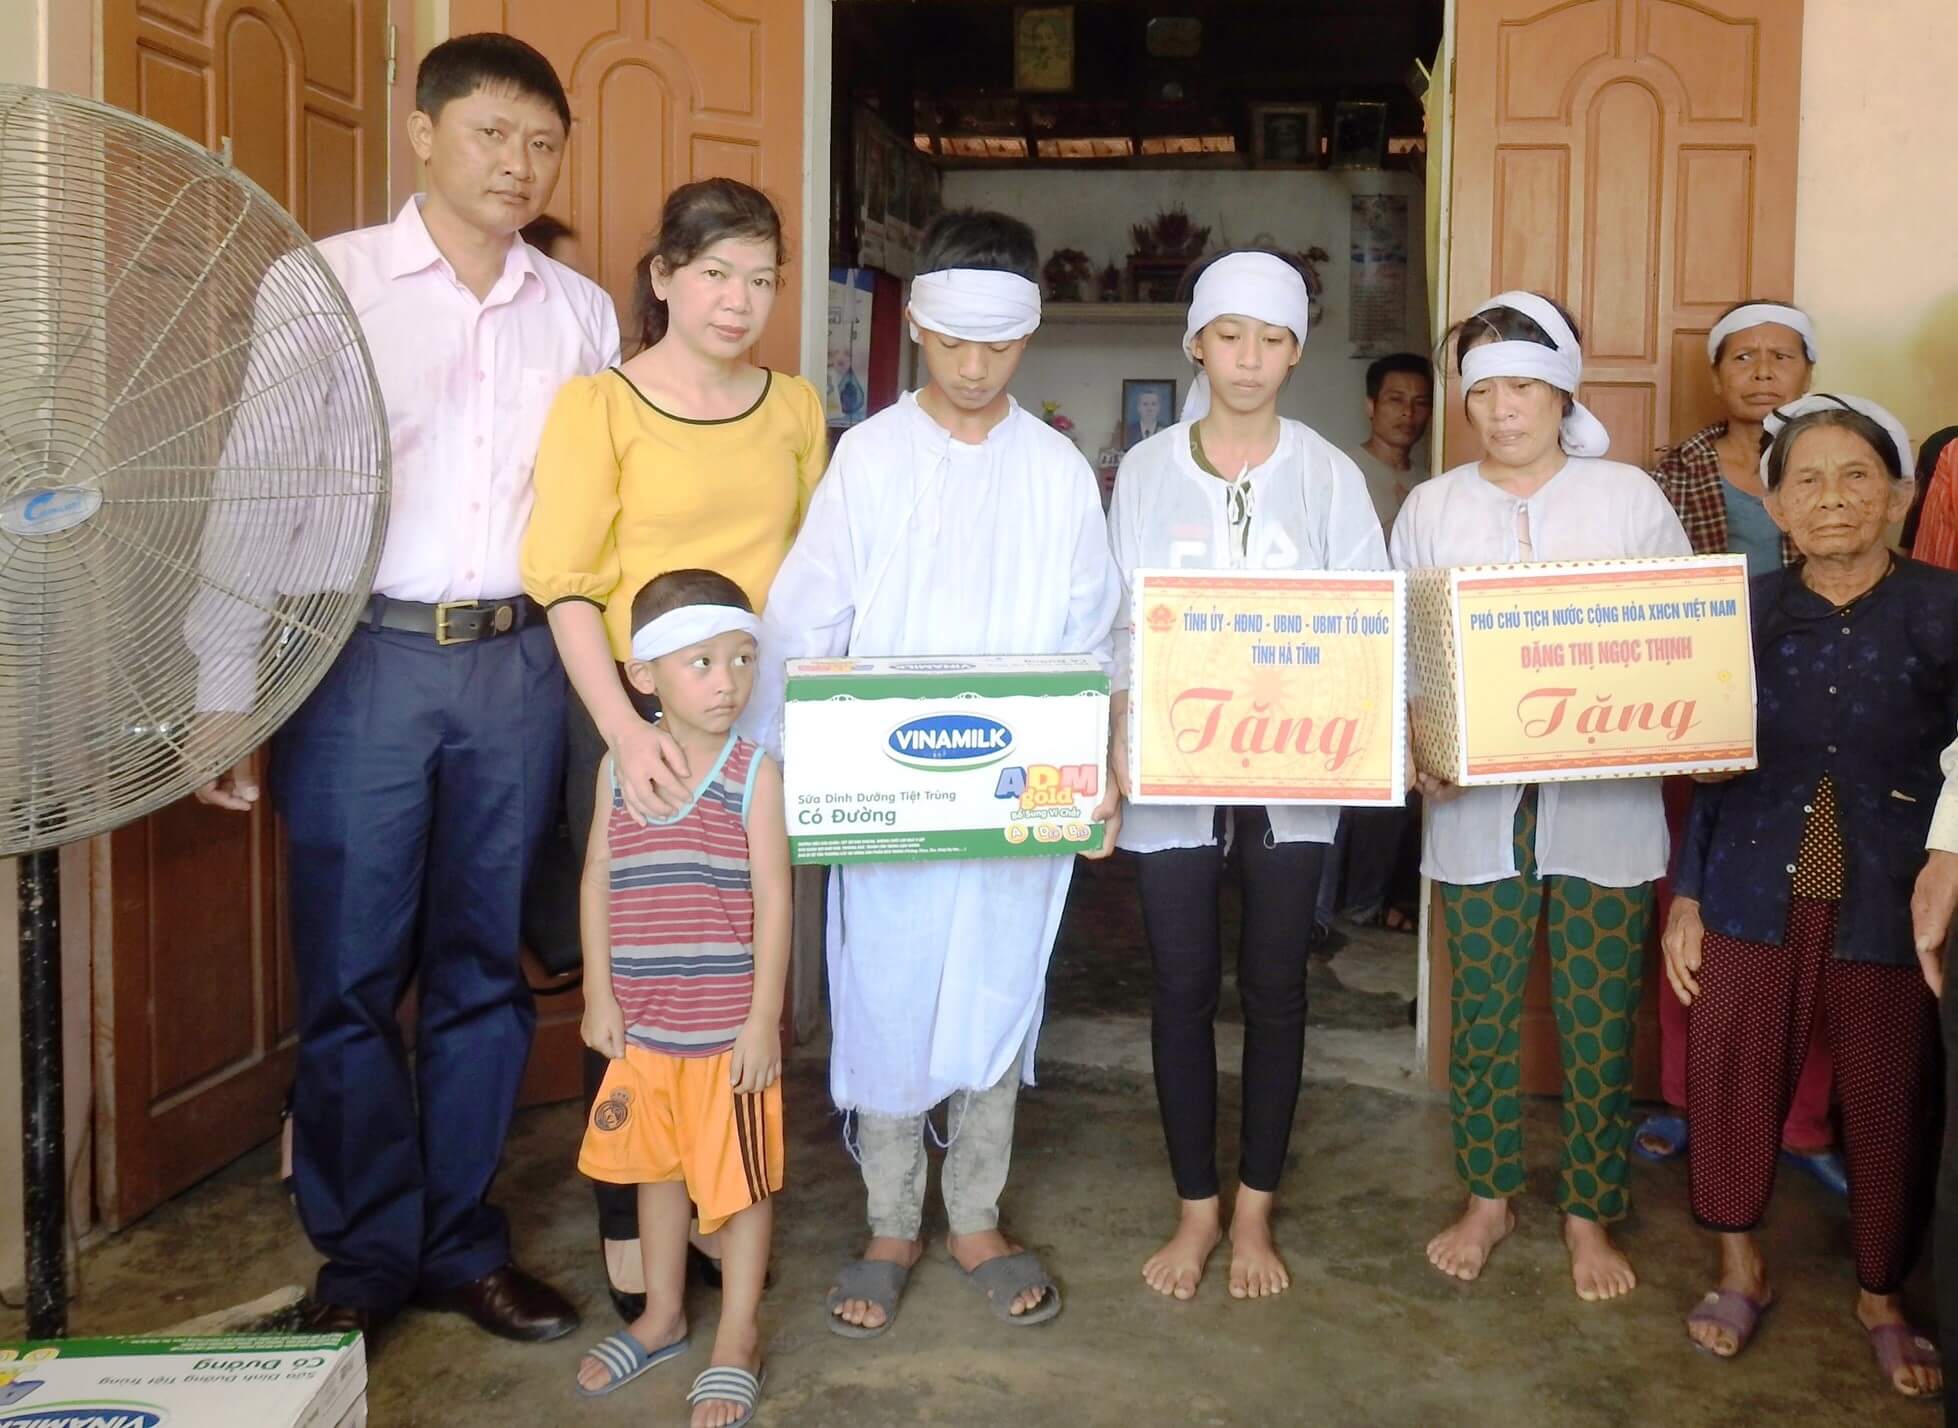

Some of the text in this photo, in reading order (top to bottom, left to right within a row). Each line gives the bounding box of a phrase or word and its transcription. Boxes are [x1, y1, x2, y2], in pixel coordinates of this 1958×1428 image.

[1183, 605, 1208, 632] TỈNH
[1210, 604, 1224, 632] ỦY
[1233, 613, 1263, 633] HĐND
[1273, 614, 1302, 634] UBND
[1312, 615, 1342, 634] UBMT
[1345, 608, 1359, 635] TỐ
[1361, 609, 1389, 635] QUỐC
[1470, 597, 1737, 632] PHÓ CHỦ TỊCH NƯỚC CỘNG HÒA XHCN VIỆT NAM
[1251, 638, 1320, 665] TỈNH HÀ TĨNH
[1568, 641, 1594, 670] THỊ
[1598, 638, 1642, 668] NGỌC
[1645, 636, 1693, 666] THỊNH
[1169, 687, 1366, 772] Tặng
[1516, 687, 1702, 745] Tặng
[895, 727, 1007, 751] VINAMILK
[994, 764, 1098, 799] ADM
[825, 792, 853, 804] Dinh
[1020, 786, 1074, 810] gold
[798, 805, 897, 826] Có Đường
[292, 1356, 326, 1370] Có
